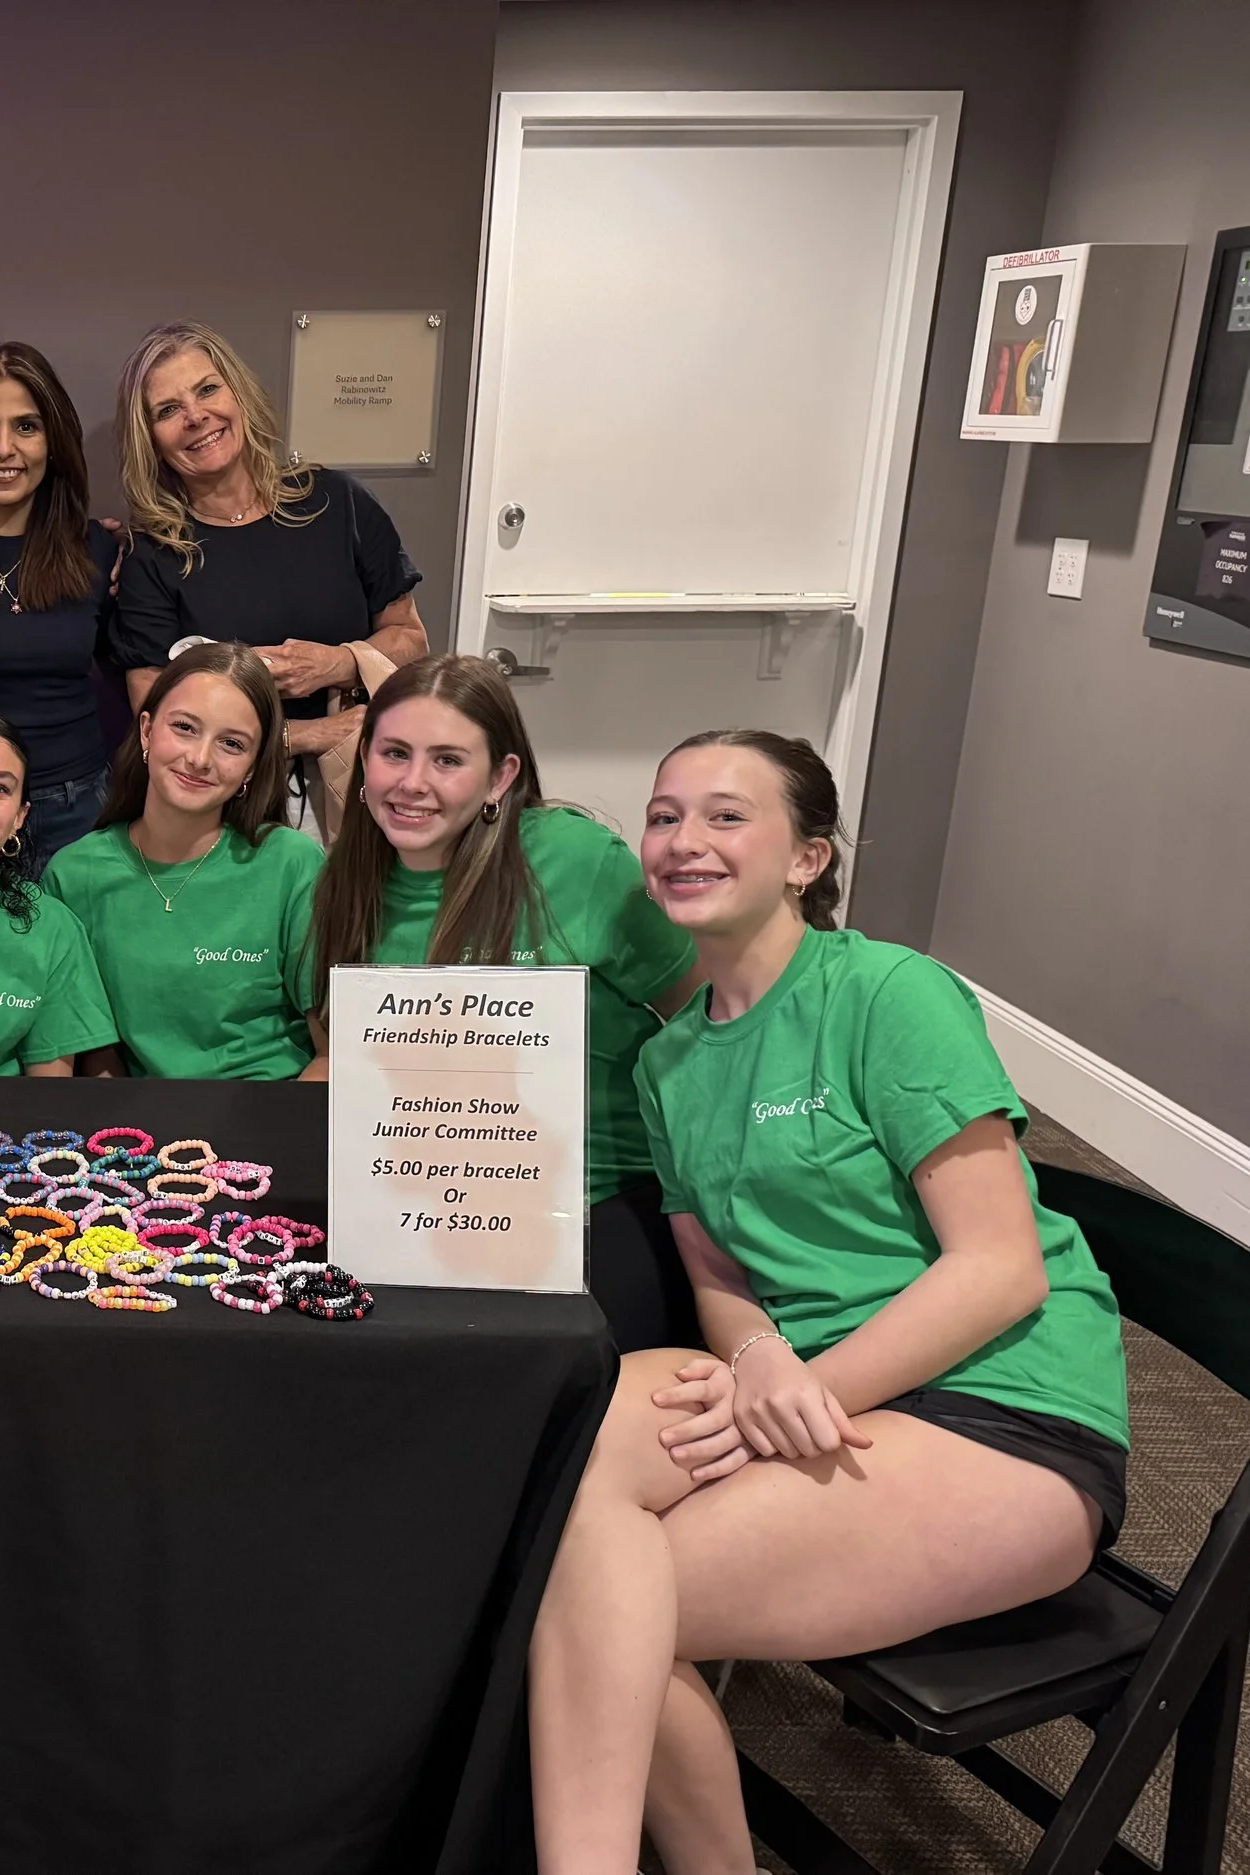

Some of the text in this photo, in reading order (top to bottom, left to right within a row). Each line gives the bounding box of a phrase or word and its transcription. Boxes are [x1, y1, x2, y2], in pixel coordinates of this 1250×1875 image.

[1003, 249, 1060, 268] DEFIBRILLATOR
[334, 373, 393, 383] Suzie and Dan
[341, 385, 387, 394] Rabinowitz
[333, 396, 393, 406] Mobility Ramp
[1220, 548, 1248, 560] MAXIMUM
[1215, 560, 1248, 573] OCCUPANCY
[193, 947, 269, 964] "Good Ones"
[7, 994, 42, 1009] Ones"
[377, 992, 534, 1018] Ann's Place
[362, 1027, 550, 1049] Friendship Bracelets
[391, 1096, 520, 1115] Fashion Show
[752, 1097, 801, 1124] "Good
[372, 1121, 538, 1142] Junior Committee
[370, 1157, 541, 1180] $5.00 per bracelet
[443, 1187, 467, 1204] Or
[400, 1211, 512, 1232] 7 for $30.00
